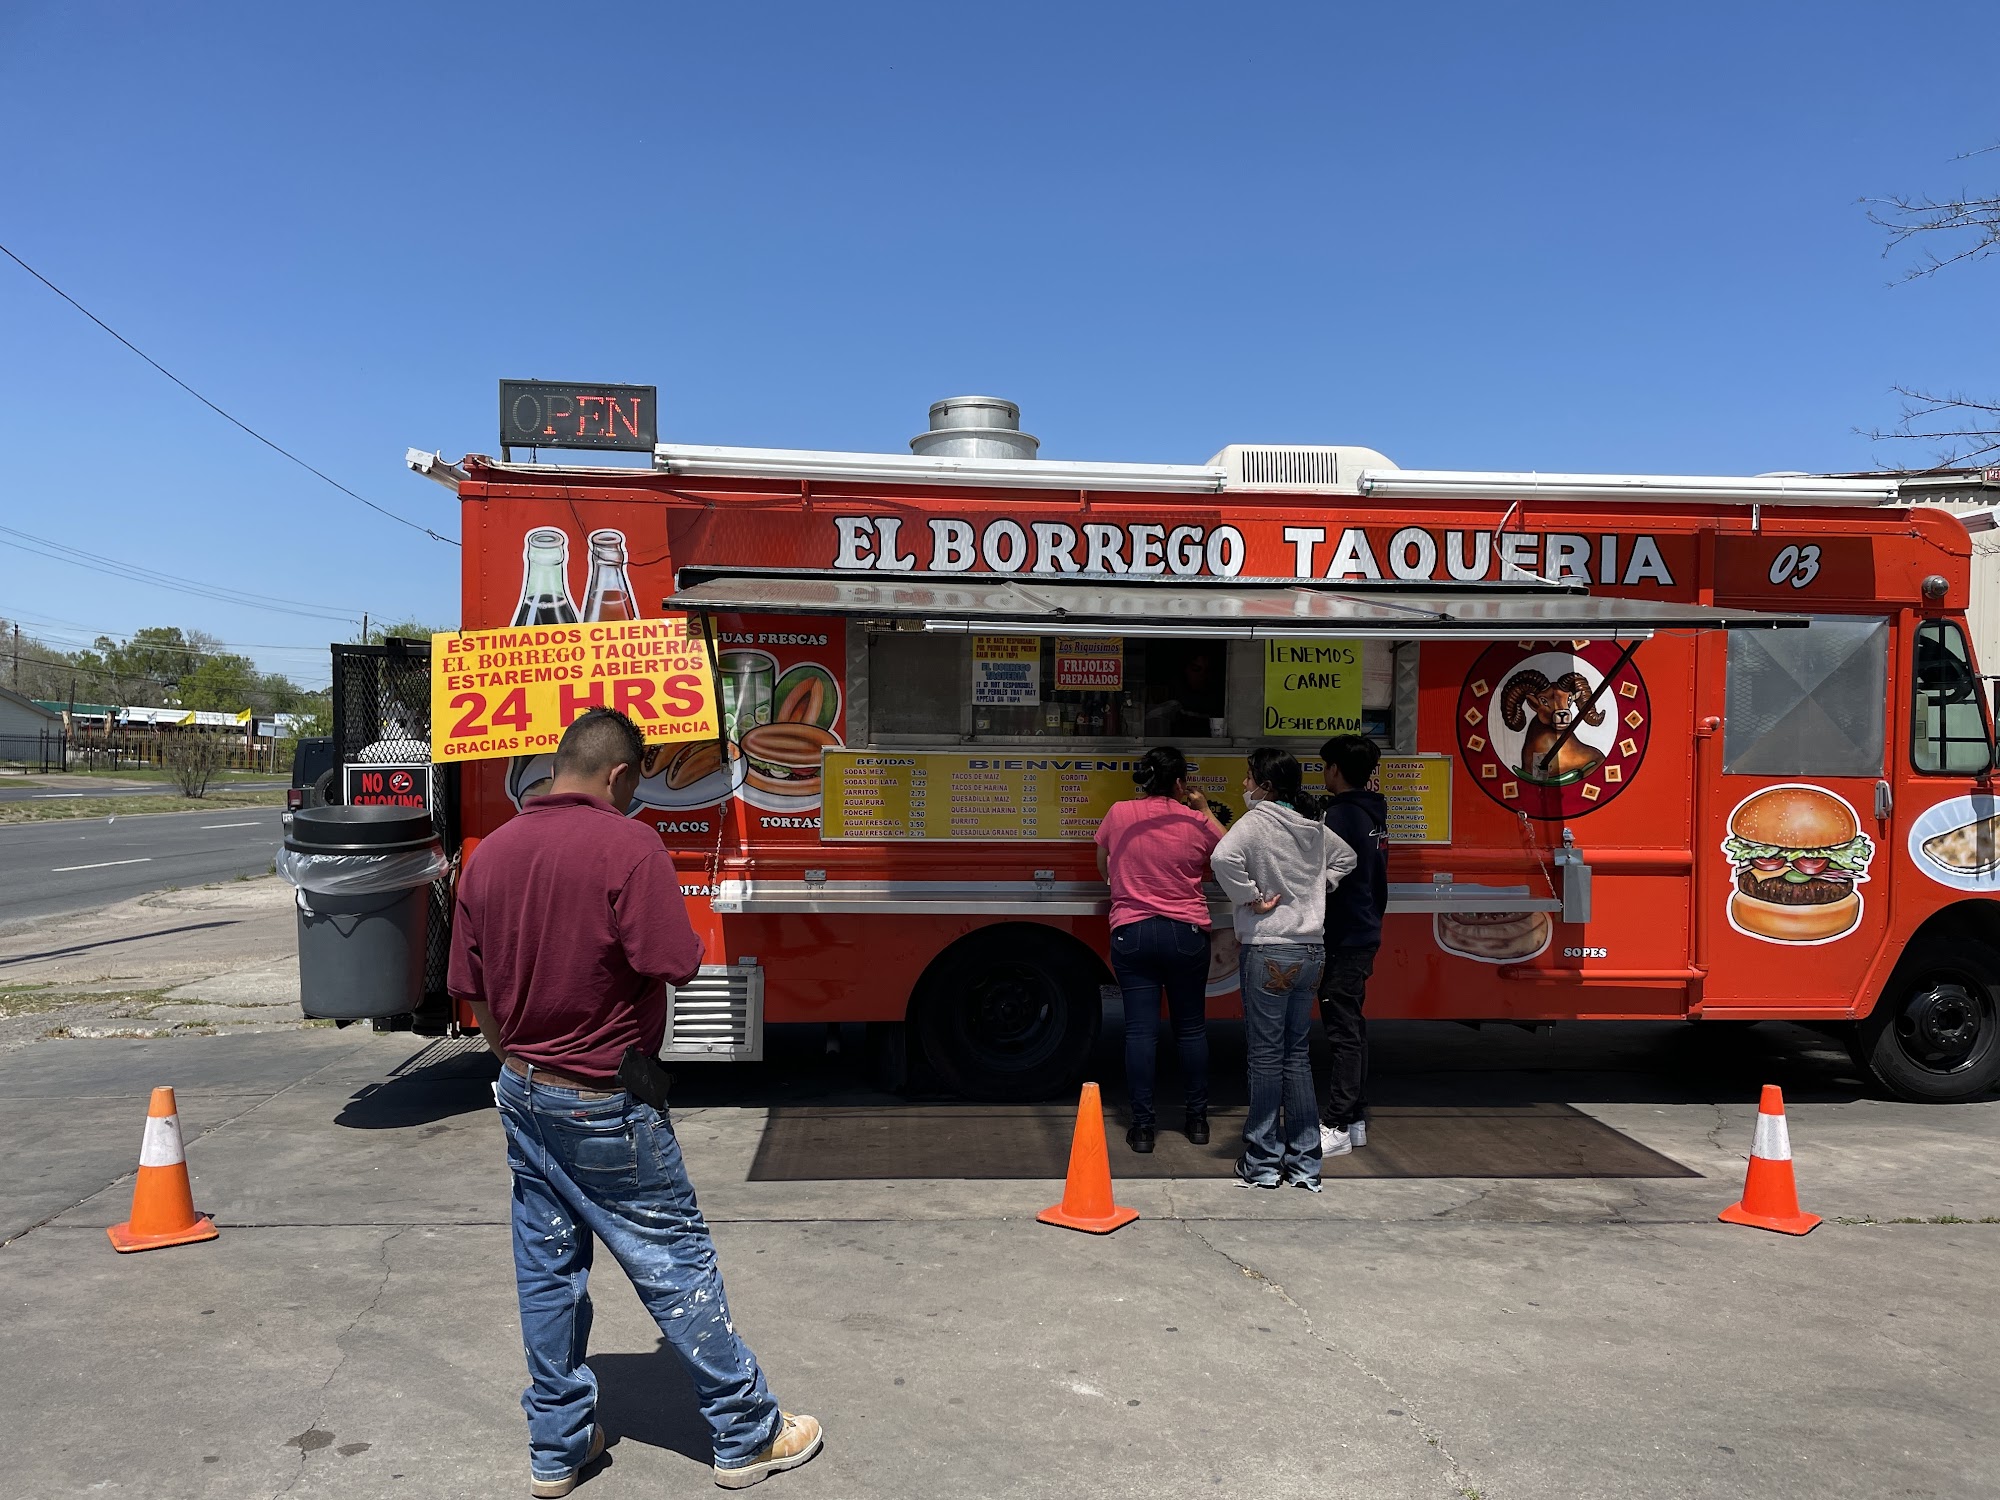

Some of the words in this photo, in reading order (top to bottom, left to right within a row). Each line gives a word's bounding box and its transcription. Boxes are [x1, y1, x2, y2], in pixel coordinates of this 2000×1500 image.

[512, 394, 641, 438] OPEN
[833, 516, 916, 571] EL
[928, 518, 1246, 577] BORREGO
[1283, 526, 1676, 587] TAQUERIA
[1768, 543, 1822, 590] 03
[447, 629, 582, 654] ESTIMADOS
[590, 622, 702, 642] CLIENTES
[717, 633, 754, 644] UAS
[758, 633, 828, 646] FRESCAS
[1059, 642, 1072, 652] Los
[442, 656, 471, 674] EL
[478, 646, 586, 670] BORREGO
[592, 640, 704, 660] TAQUERIA
[1064, 660, 1116, 672] FRIJOLES
[447, 665, 584, 690] ESTAREMOS
[590, 656, 704, 678] ABIERTOS
[1060, 674, 1118, 685] PREPARADOS
[1284, 672, 1342, 690] CARNE
[449, 688, 533, 738] 24
[558, 674, 705, 728] HRS
[444, 737, 519, 756] GRACIAS
[524, 733, 559, 748] POR
[640, 721, 710, 736] RENCIA
[362, 772, 384, 793] NO
[354, 794, 424, 809] SMOKING
[656, 821, 710, 833] TACOS
[760, 816, 822, 828] TORTAS
[1564, 947, 1608, 958] SOPES
